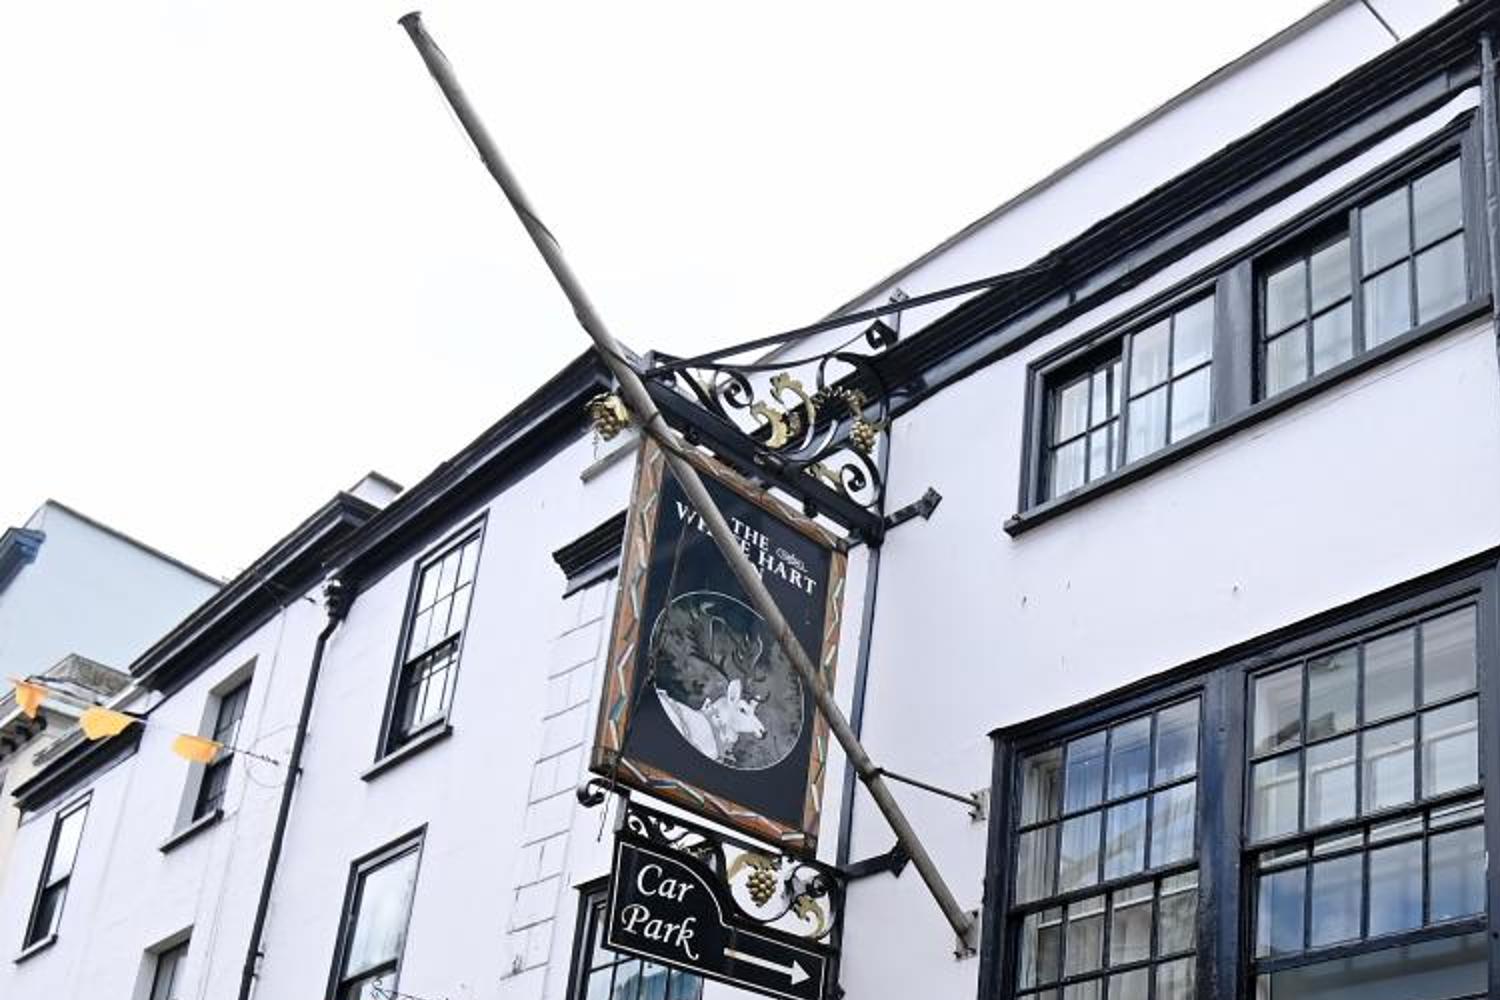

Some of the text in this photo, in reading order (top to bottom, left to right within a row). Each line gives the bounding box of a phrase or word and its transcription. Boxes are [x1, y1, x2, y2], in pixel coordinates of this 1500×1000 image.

[731, 517, 770, 551] THE
[759, 550, 817, 596] HART
[637, 864, 694, 902] Car
[621, 904, 699, 960] Park
